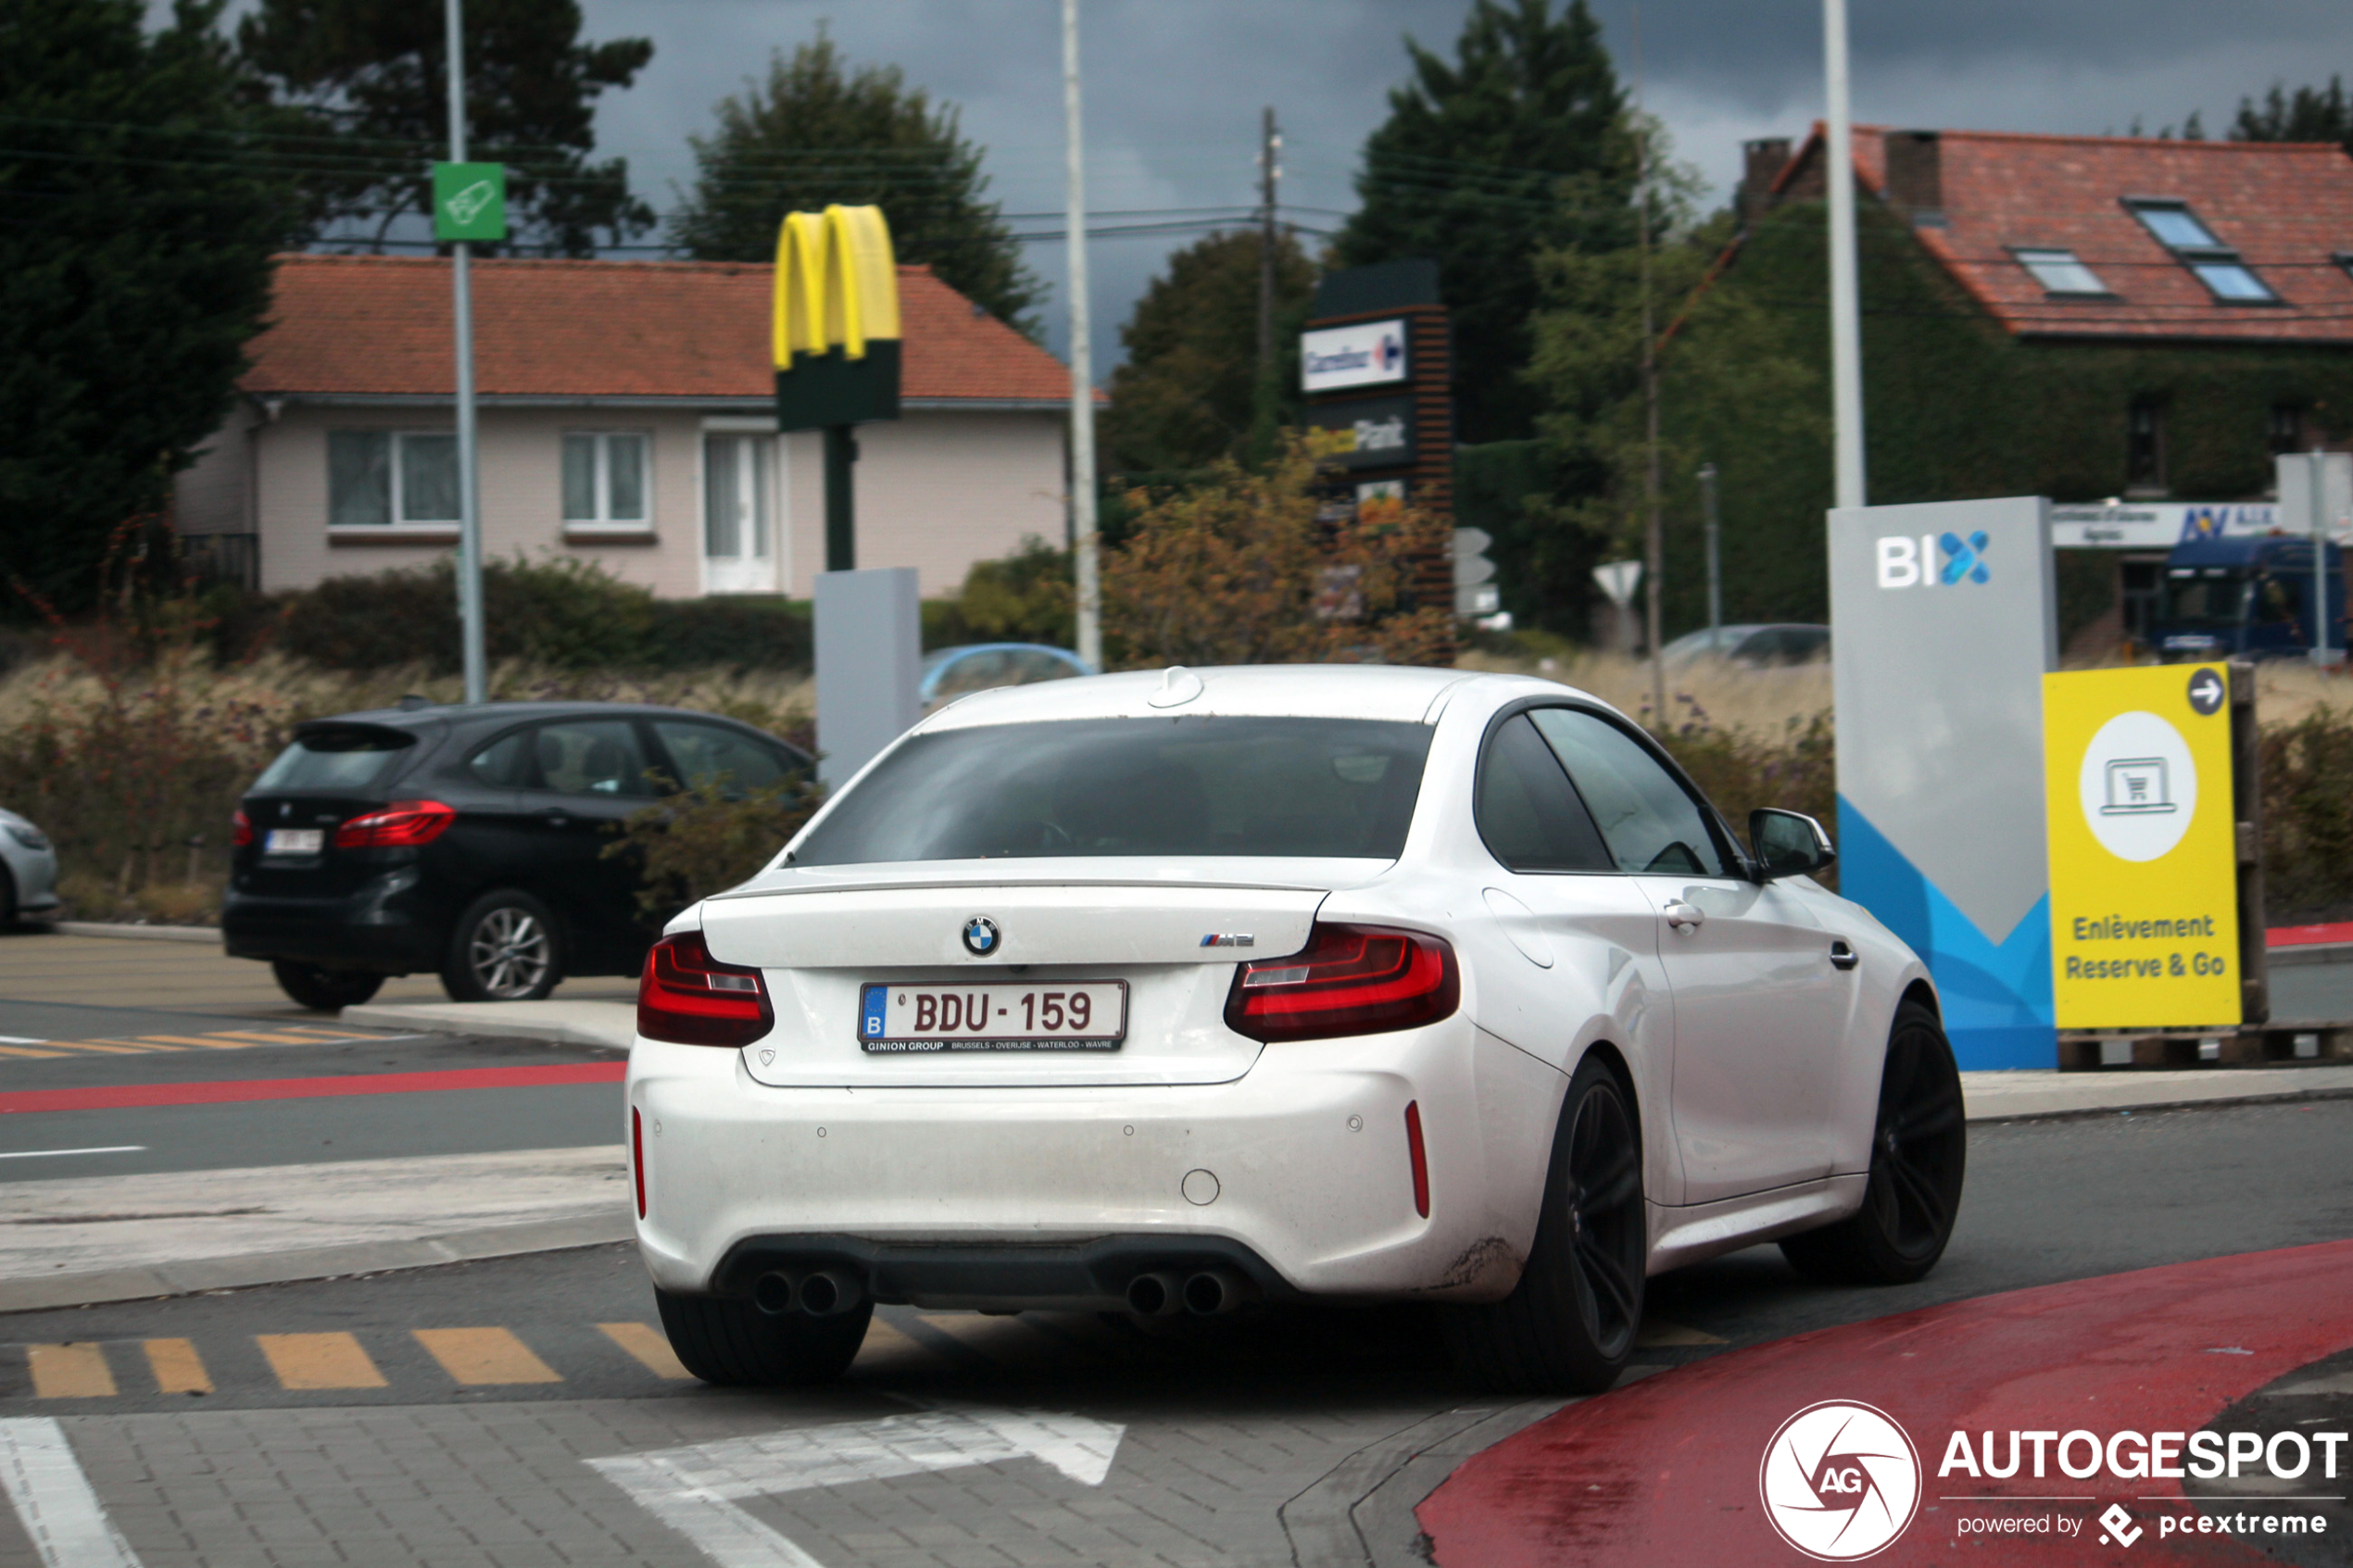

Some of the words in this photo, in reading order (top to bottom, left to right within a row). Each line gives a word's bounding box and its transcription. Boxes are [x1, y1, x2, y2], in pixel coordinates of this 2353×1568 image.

[2073, 914, 2215, 940] Enlèvement
[2065, 955, 2162, 979] Reserve
[2169, 953, 2185, 976] &
[2193, 951, 2225, 976] Go
[867, 1017, 881, 1035] B
[868, 1042, 906, 1050] GINION
[908, 1042, 944, 1050] GROUP
[1085, 1040, 1112, 1048] WAVRE
